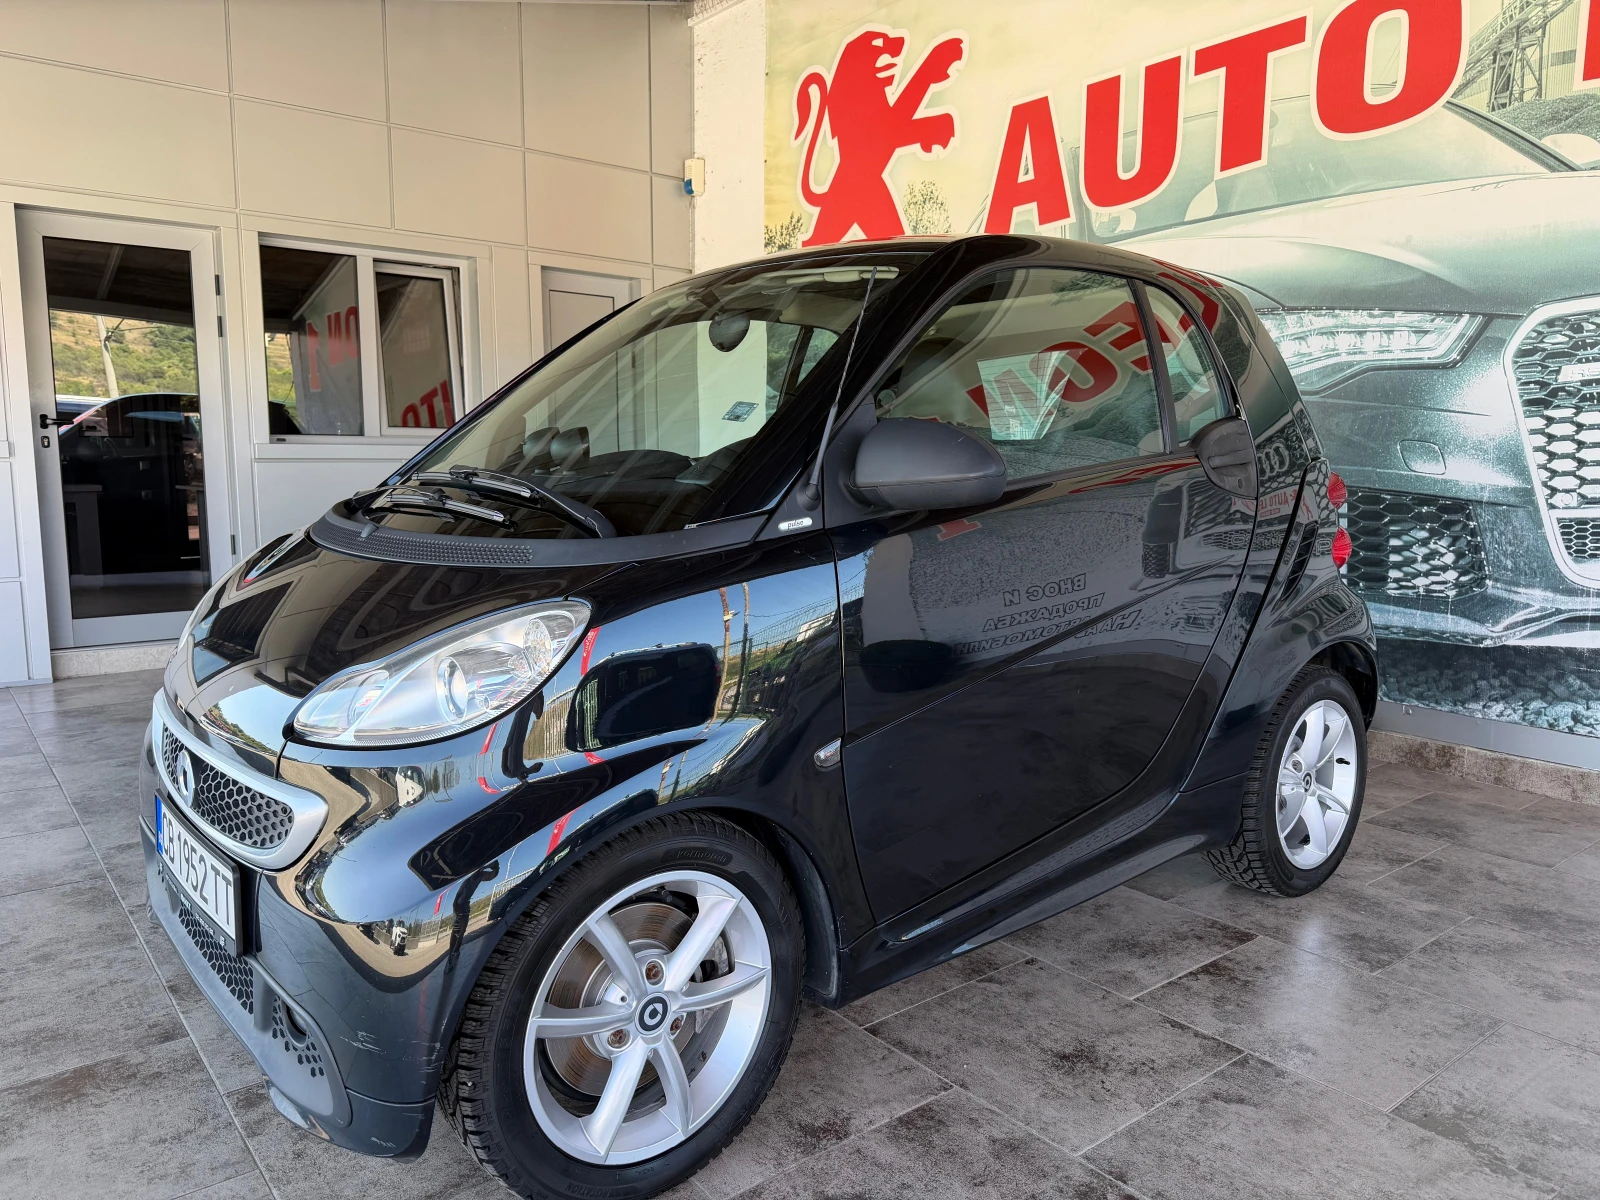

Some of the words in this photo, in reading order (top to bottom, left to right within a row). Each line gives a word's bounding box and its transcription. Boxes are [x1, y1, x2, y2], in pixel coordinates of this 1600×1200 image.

[984, 0, 1463, 234] AUTO
[787, 520, 804, 530] pulse
[177, 830, 209, 906] 1952
[210, 862, 232, 926] TT
[564, 1182, 611, 1198] ROTATION
